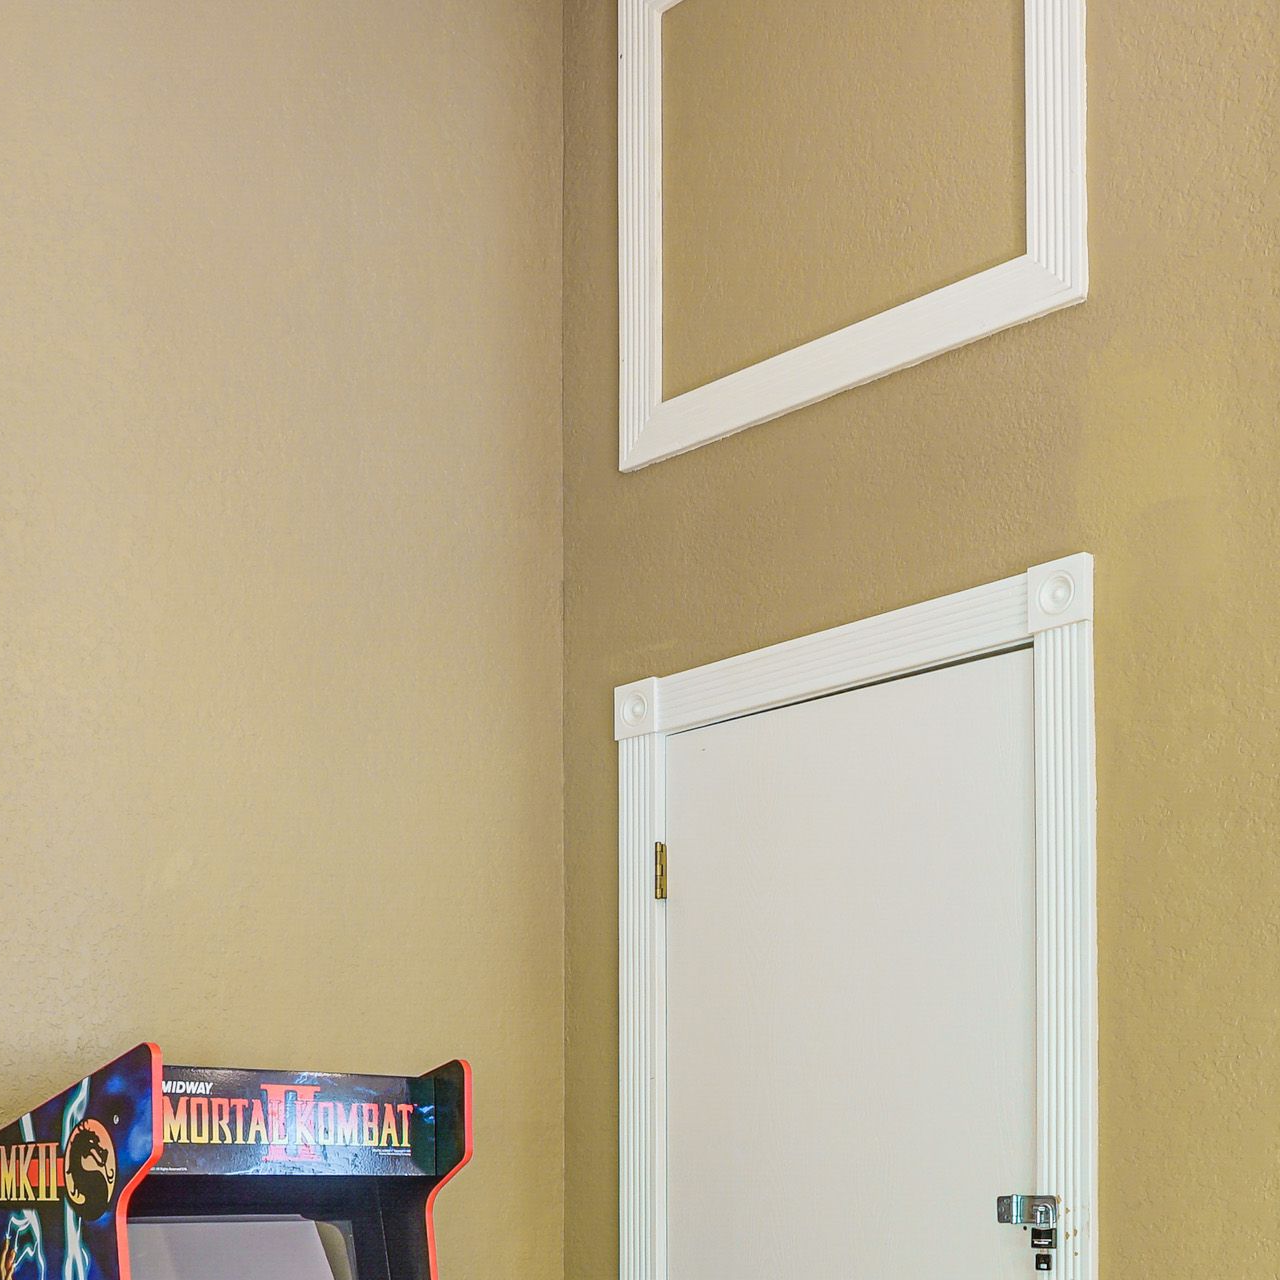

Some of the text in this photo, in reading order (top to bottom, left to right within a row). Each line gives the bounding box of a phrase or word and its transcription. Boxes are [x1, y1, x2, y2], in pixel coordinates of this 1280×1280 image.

[162, 1080, 214, 1095] MIDWAY
[162, 1096, 414, 1147] MORTAL KOMBAT
